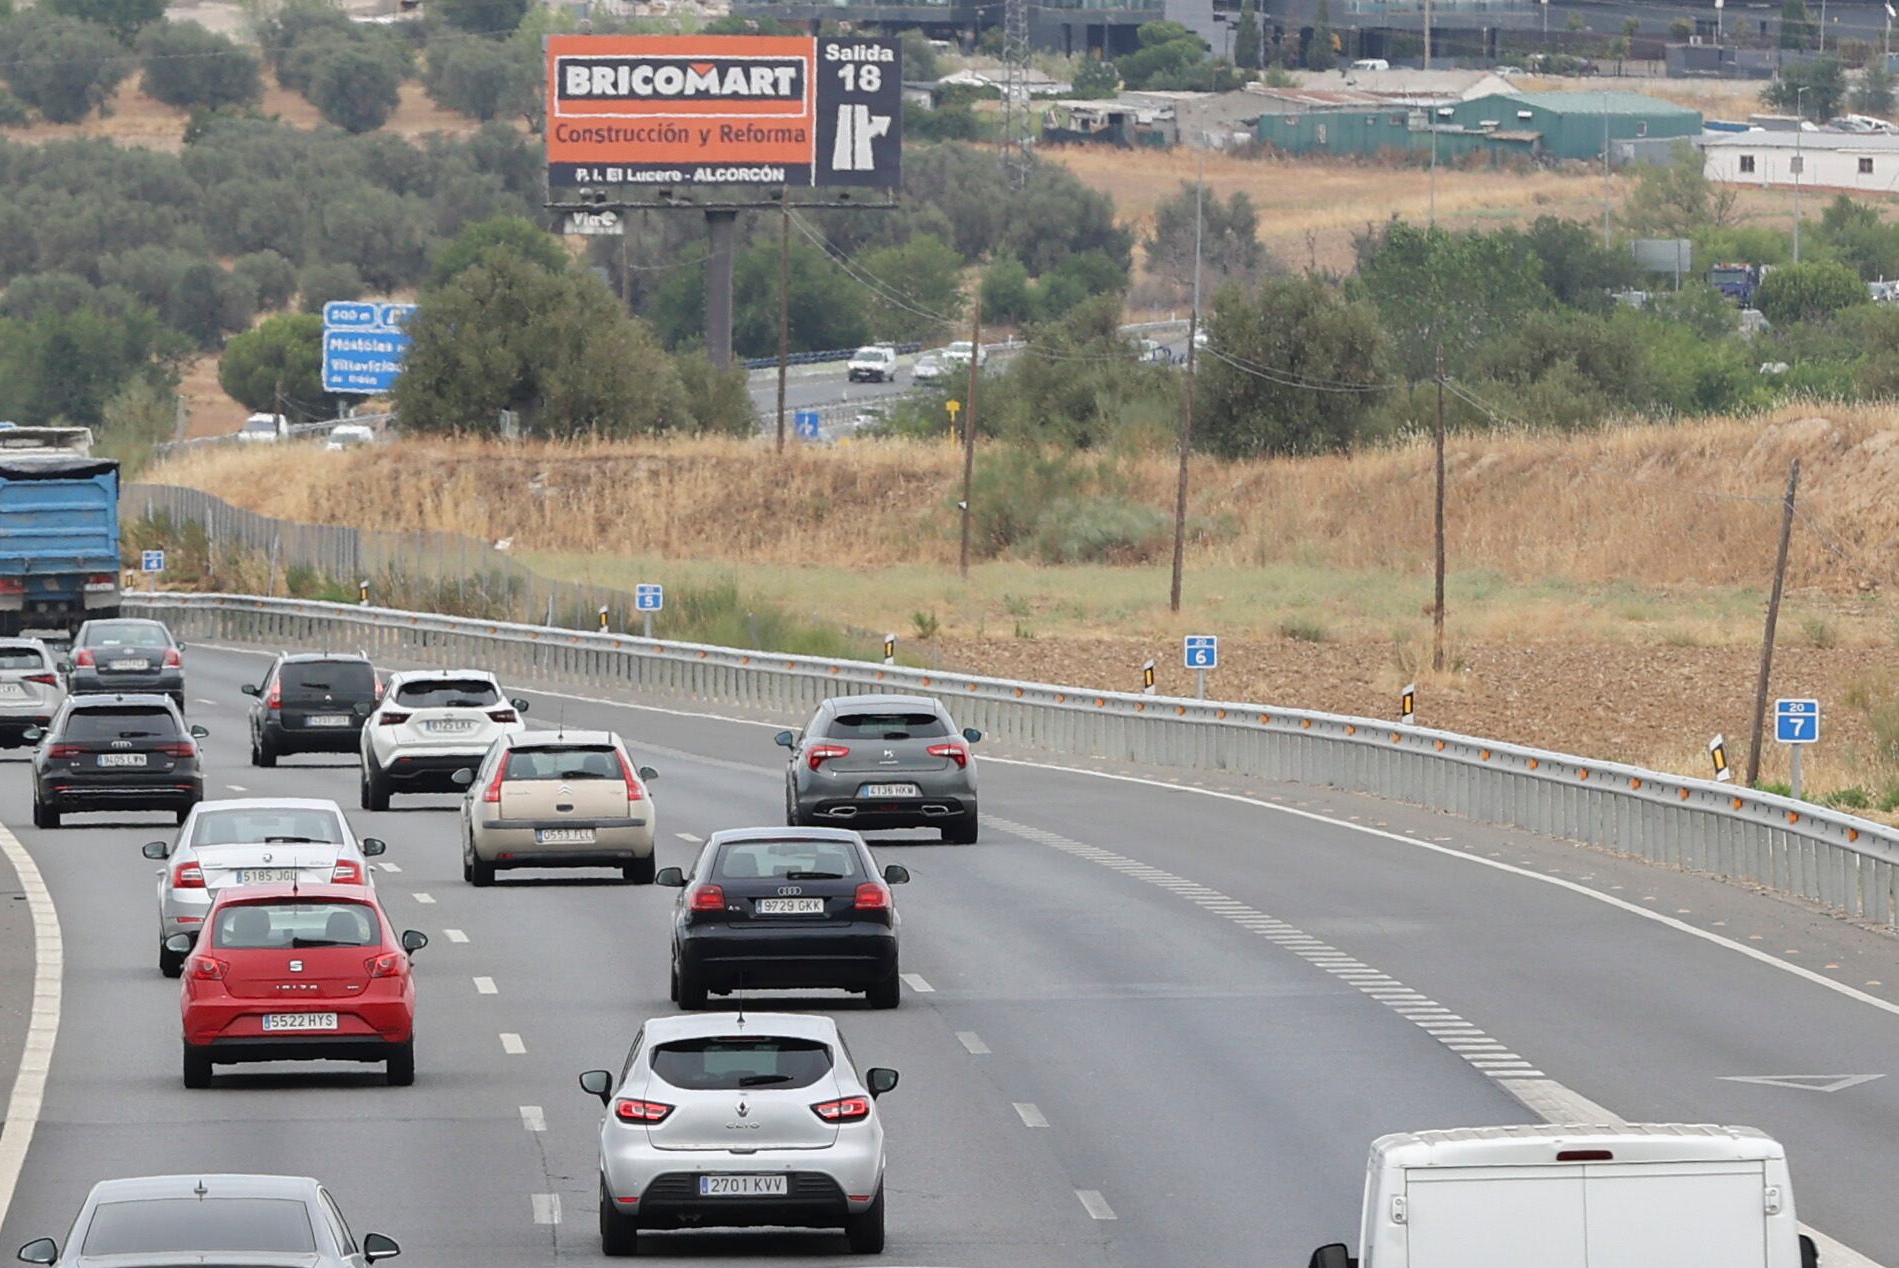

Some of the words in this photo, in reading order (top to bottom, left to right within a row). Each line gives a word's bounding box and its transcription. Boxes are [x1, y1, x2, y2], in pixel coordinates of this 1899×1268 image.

[825, 44, 895, 62] Salida
[565, 63, 798, 97] BRICOMART
[837, 63, 882, 92] 18
[555, 122, 690, 145] Construcción
[699, 127, 712, 147] y
[720, 123, 807, 144] Reforma
[606, 168, 623, 182] El
[627, 167, 683, 182] Lucero
[693, 164, 786, 182] ALCORCÓN
[330, 309, 358, 321] 500
[329, 338, 393, 353] Móstoles
[1195, 649, 1207, 665] 6
[1788, 702, 1806, 713] 20
[1788, 718, 1805, 737] 7
[243, 870, 273, 881] 5185
[763, 899, 795, 911] 9729
[798, 899, 821, 911] GKK
[271, 1015, 306, 1027] 5522
[308, 1014, 333, 1026] HYS
[725, 1121, 760, 1130] CLIO
[710, 1178, 748, 1192] 2701
[753, 1177, 783, 1192] KVV
